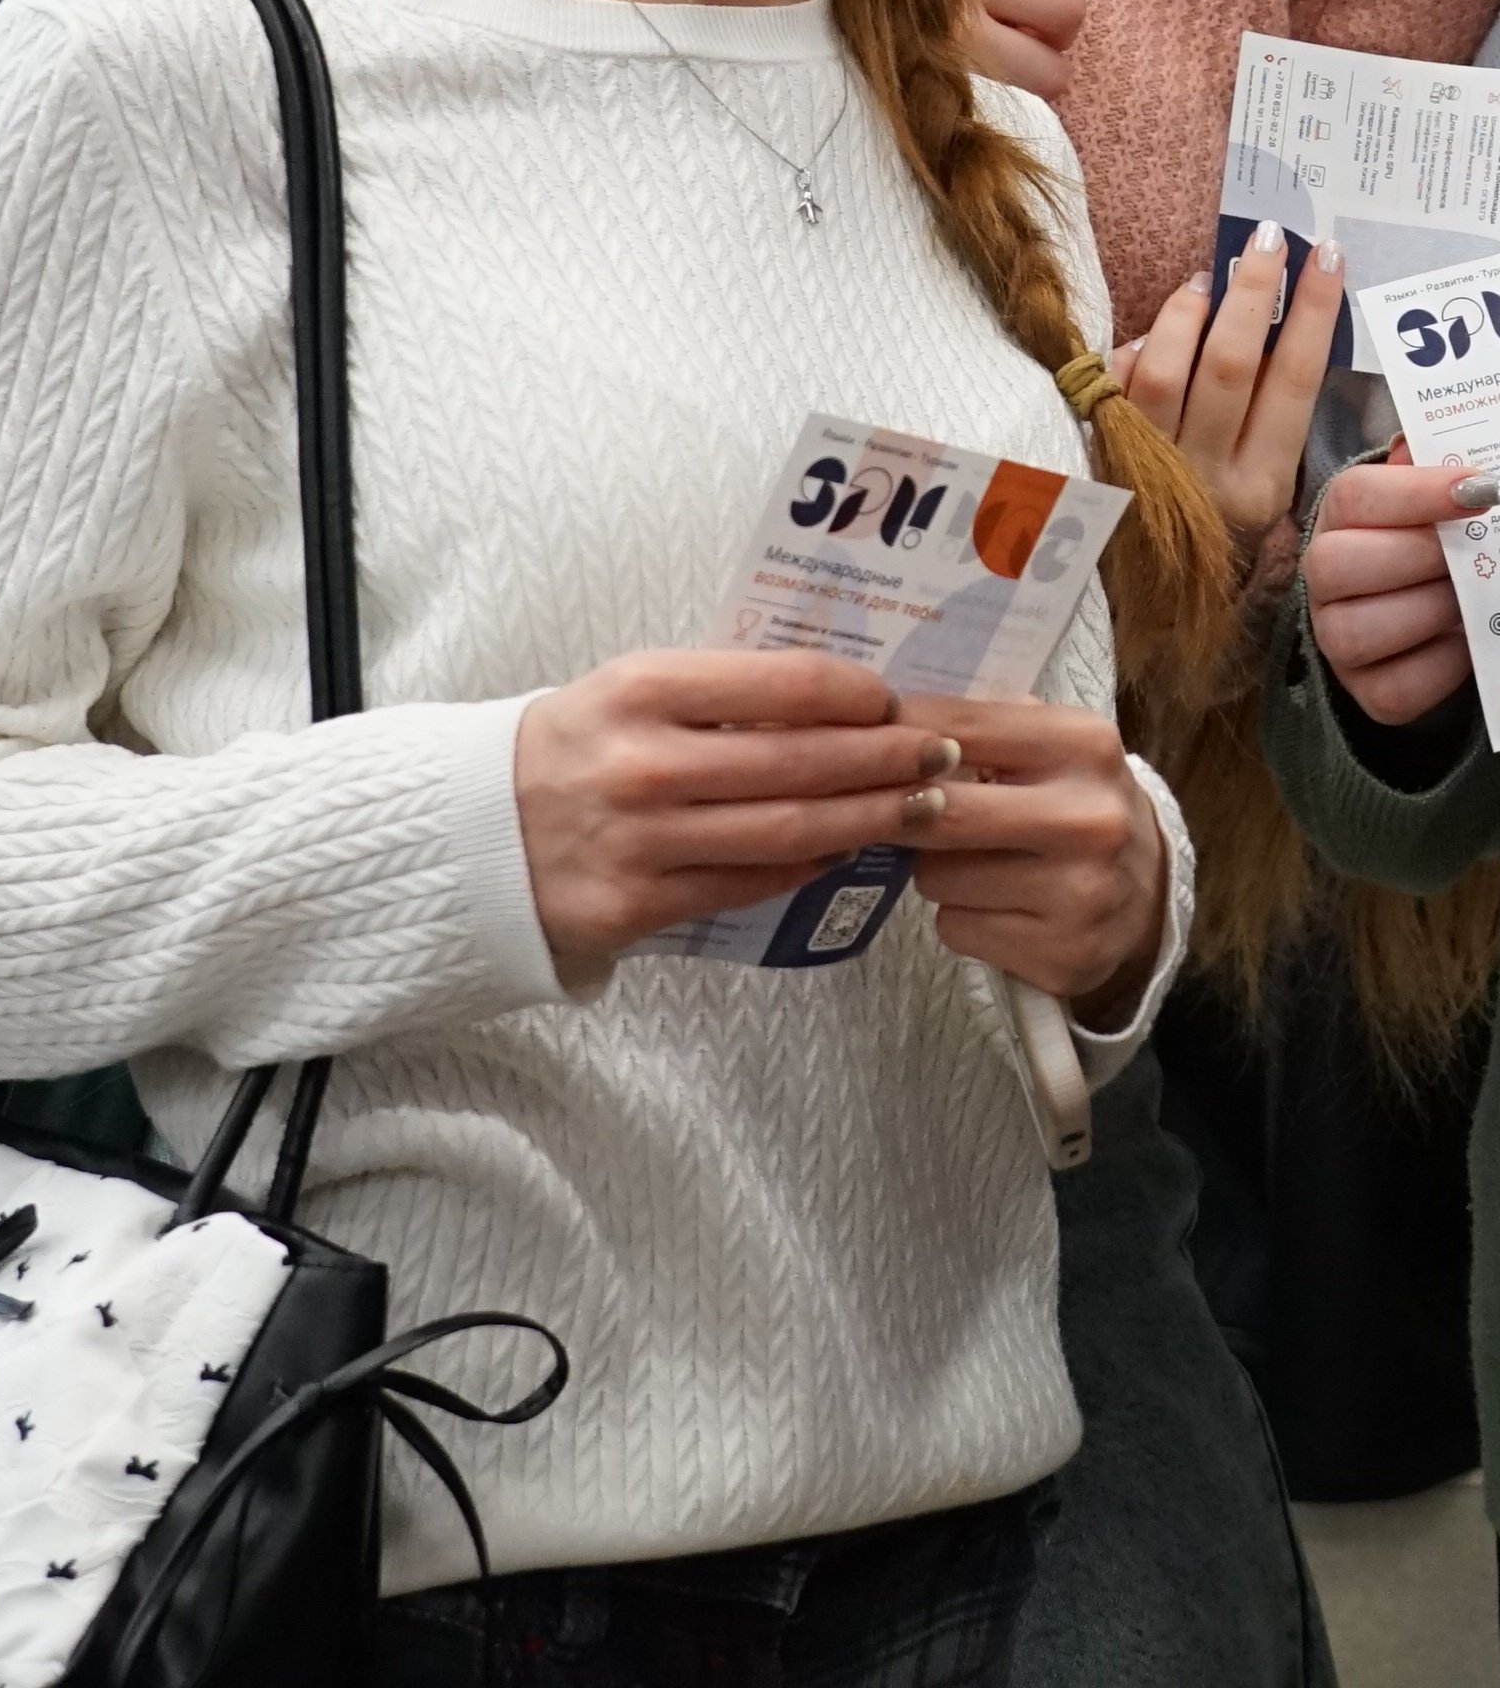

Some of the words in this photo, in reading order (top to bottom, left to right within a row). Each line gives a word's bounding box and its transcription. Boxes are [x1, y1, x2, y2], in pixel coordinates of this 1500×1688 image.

[1383, 286, 1418, 304] Языки
[1425, 272, 1475, 293] Развитие
[763, 543, 904, 591] Международные
